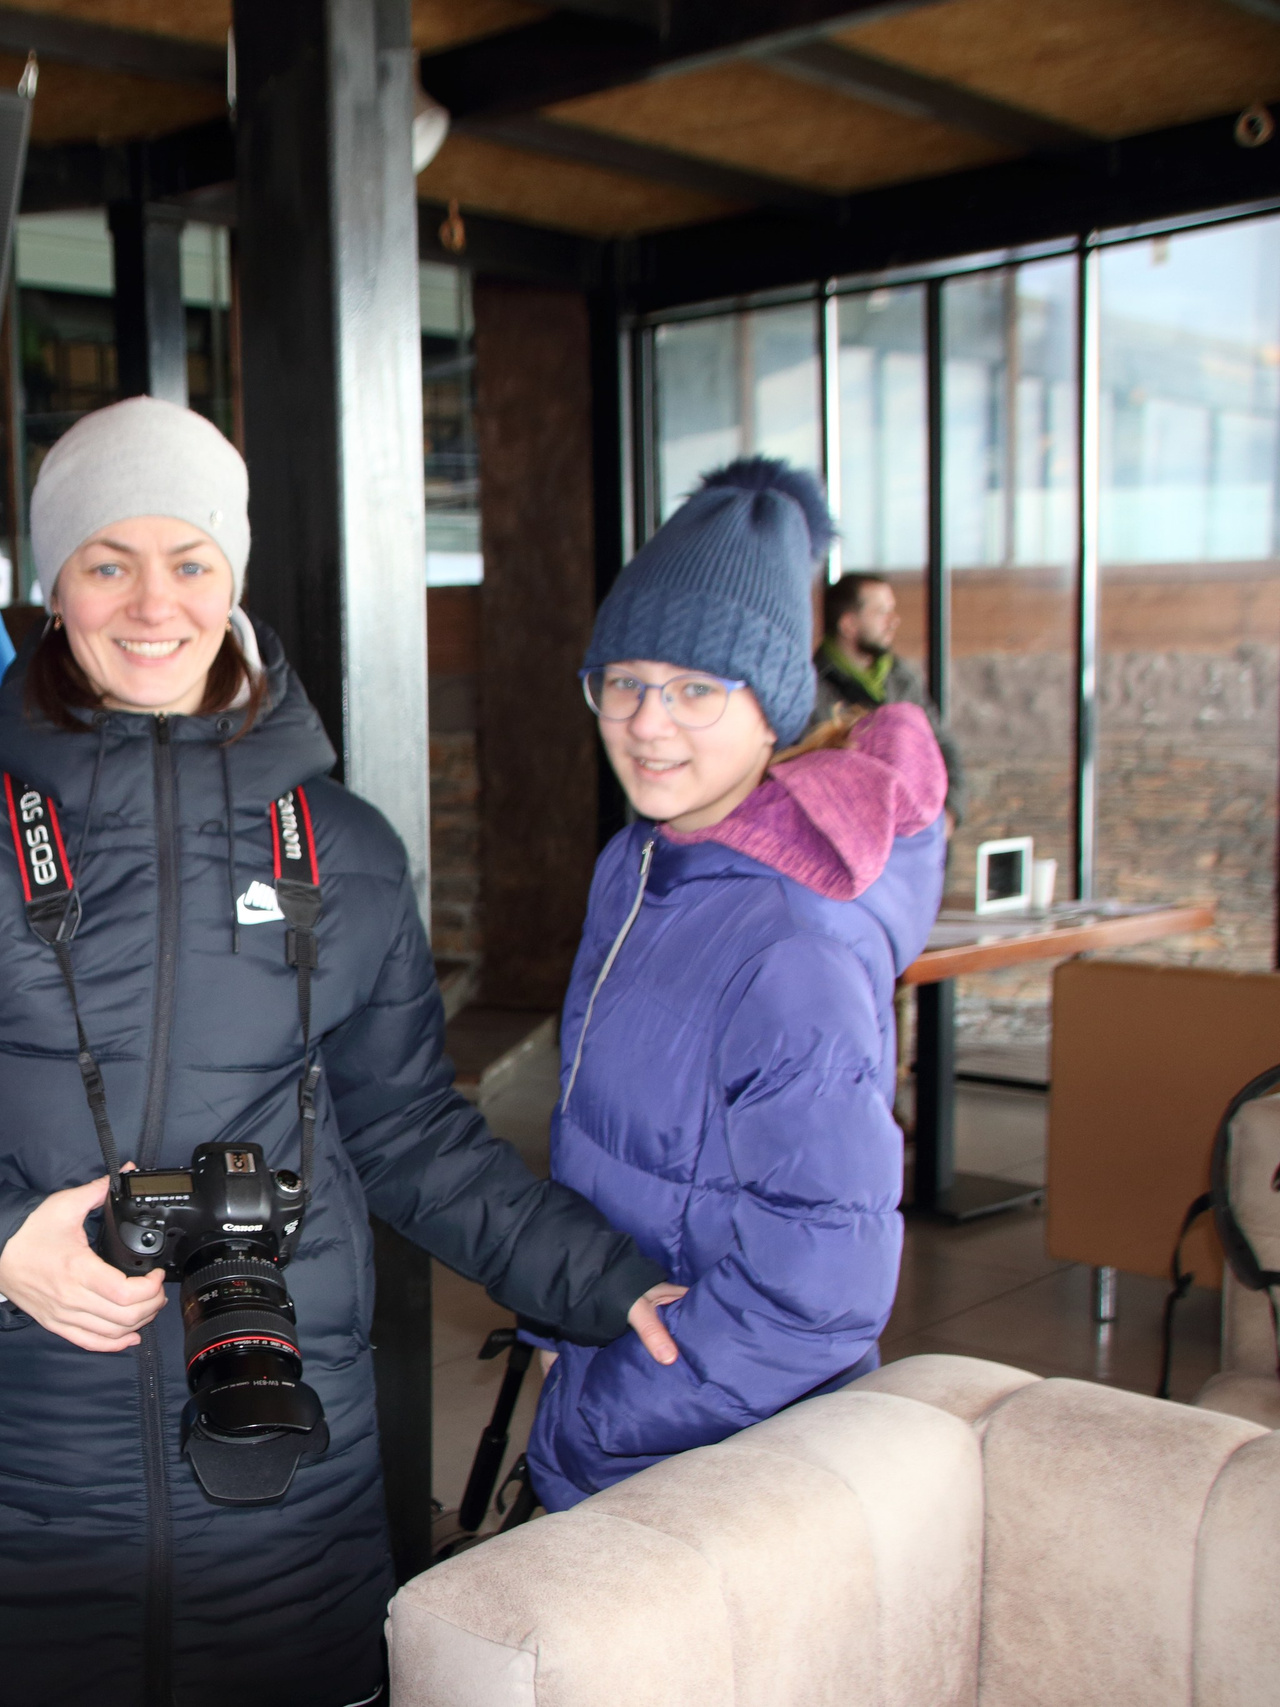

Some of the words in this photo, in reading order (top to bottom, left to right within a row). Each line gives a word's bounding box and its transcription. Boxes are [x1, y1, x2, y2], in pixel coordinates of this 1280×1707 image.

[20, 790, 44, 823] 5D
[26, 824, 58, 886] EOS
[222, 1223, 263, 1232] Canon
